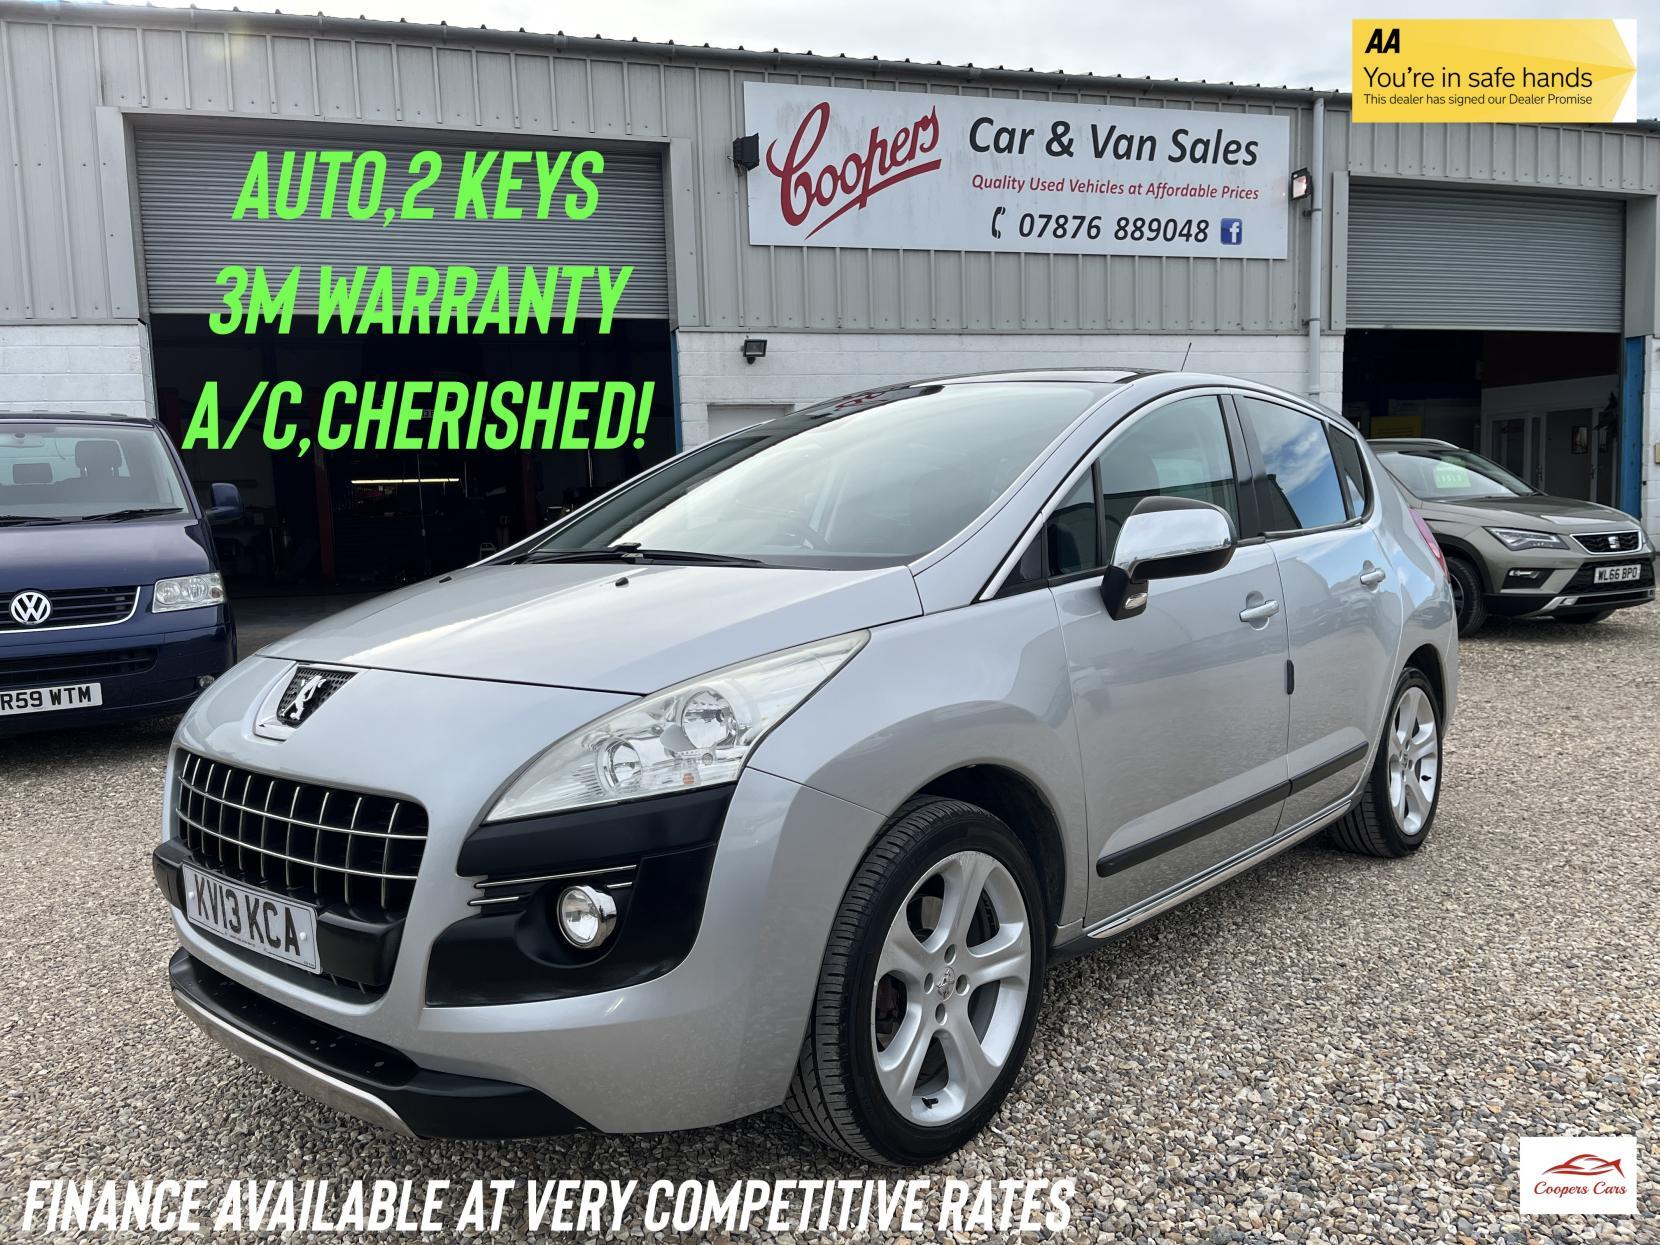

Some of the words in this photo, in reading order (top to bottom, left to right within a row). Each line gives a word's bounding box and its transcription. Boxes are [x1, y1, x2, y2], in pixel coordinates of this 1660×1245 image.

[969, 116, 1035, 155] Car
[1045, 120, 1075, 158] &
[1091, 123, 1158, 162] Van
[1168, 128, 1259, 167] Sales
[766, 101, 941, 232] Coopers
[971, 174, 1026, 194] Quality
[1029, 177, 1066, 193] Used
[1069, 179, 1125, 196] Vehicles
[1128, 182, 1143, 196] at
[1146, 182, 1218, 199] Affordable
[1221, 185, 1260, 200] Prices
[1018, 212, 1102, 240] 07876
[1113, 216, 1210, 243] 889048
[1, 690, 42, 711] R59
[49, 685, 92, 706] WTM
[194, 873, 242, 935] KV13
[244, 894, 301, 957] KCA
